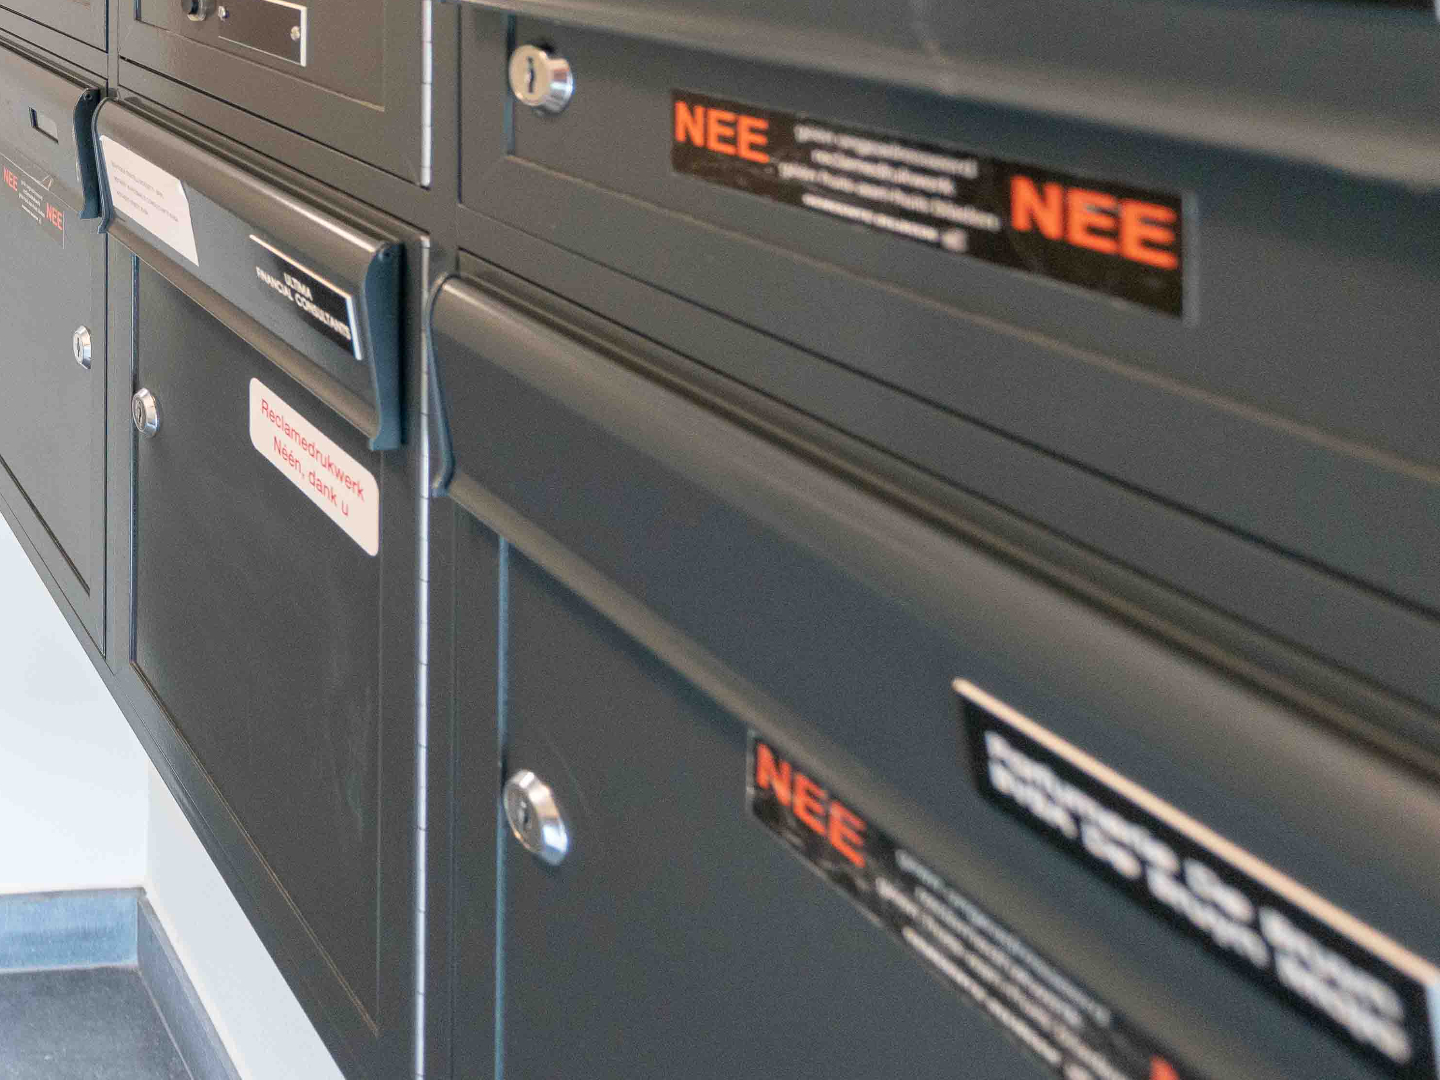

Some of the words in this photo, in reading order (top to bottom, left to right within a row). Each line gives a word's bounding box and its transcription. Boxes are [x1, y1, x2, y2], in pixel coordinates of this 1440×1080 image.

[672, 100, 771, 165] NEE
[3, 166, 18, 192] NEE
[46, 202, 63, 231] NEE
[1008, 174, 1179, 271] NEE
[260, 398, 365, 503] Reclamedrukwerk
[308, 470, 338, 508] dank
[341, 499, 349, 517] u
[756, 743, 867, 869] NEE
